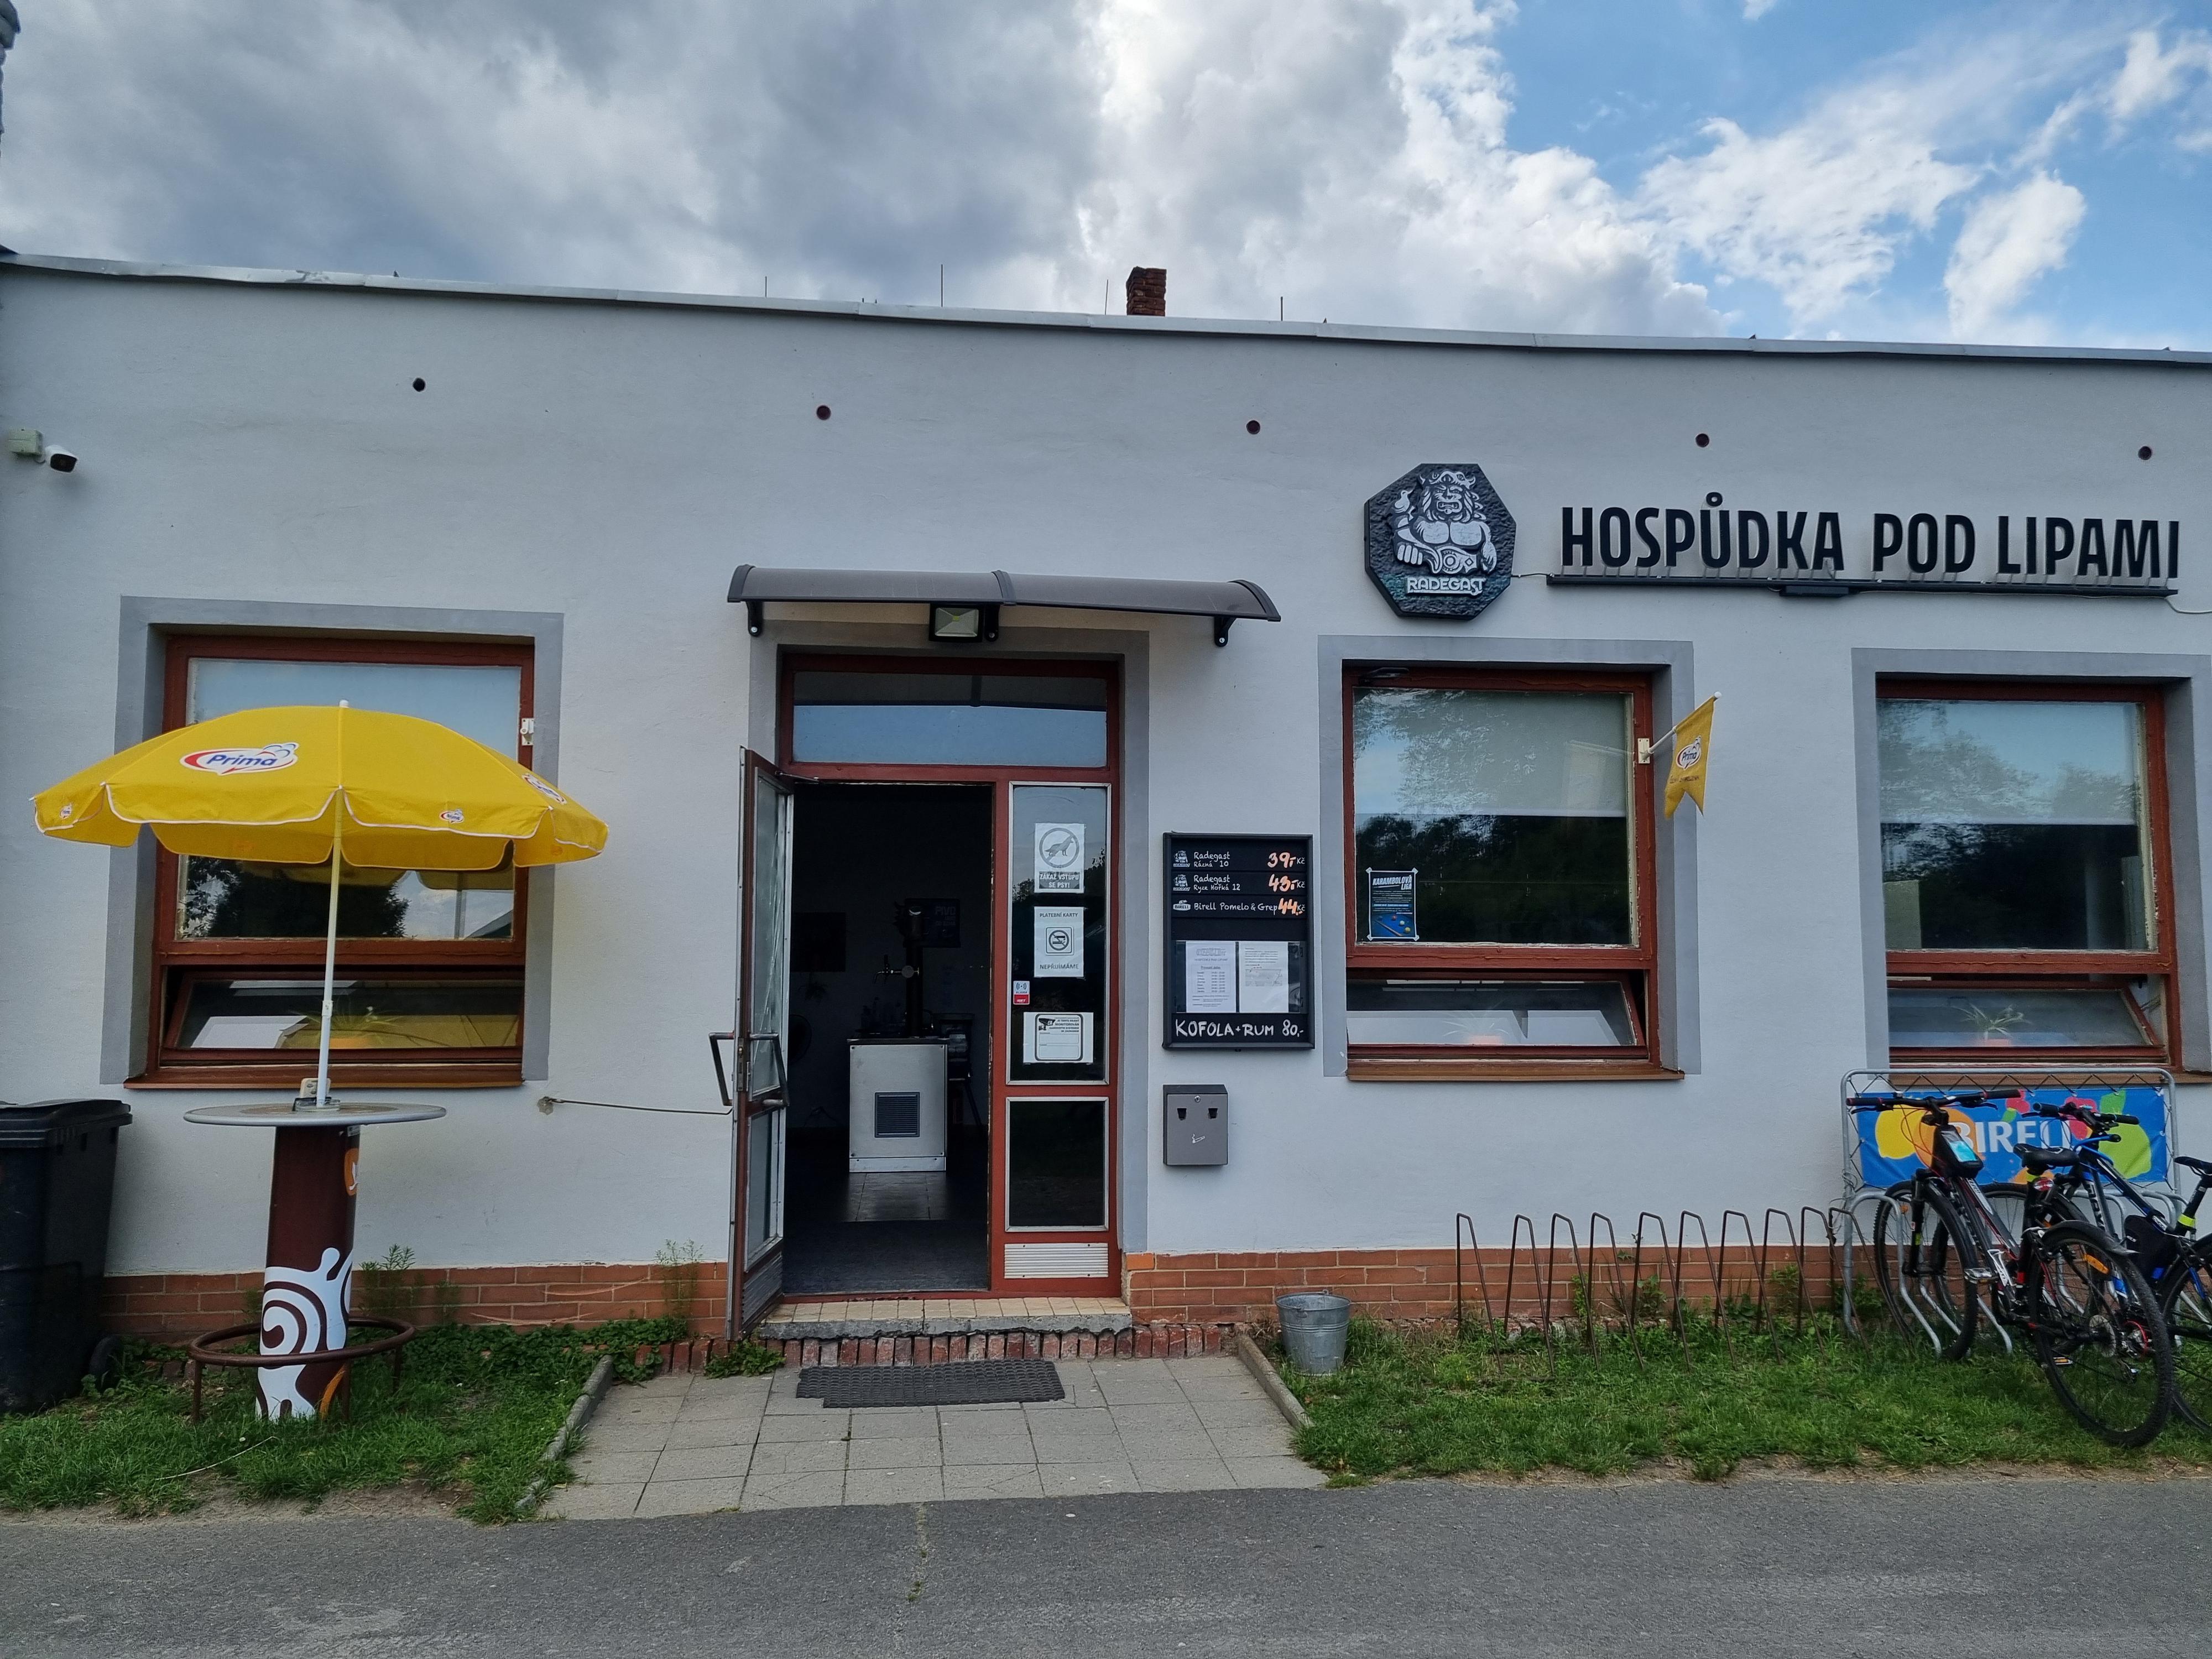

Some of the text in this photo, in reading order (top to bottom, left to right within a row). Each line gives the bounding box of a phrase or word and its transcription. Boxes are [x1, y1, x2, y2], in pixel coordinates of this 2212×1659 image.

[1561, 492, 2179, 579] HOSPŮDKA POD LIPAMI
[1407, 578, 1486, 596] RADEGAST
[206, 754, 278, 766] Prima
[1194, 851, 1230, 862] Radegast
[1194, 874, 1230, 885] Radegast
[1373, 875, 1412, 885] KARAMBOLOVÁ
[1220, 902, 1249, 911] Pomelo
[1258, 903, 1277, 915] Grep
